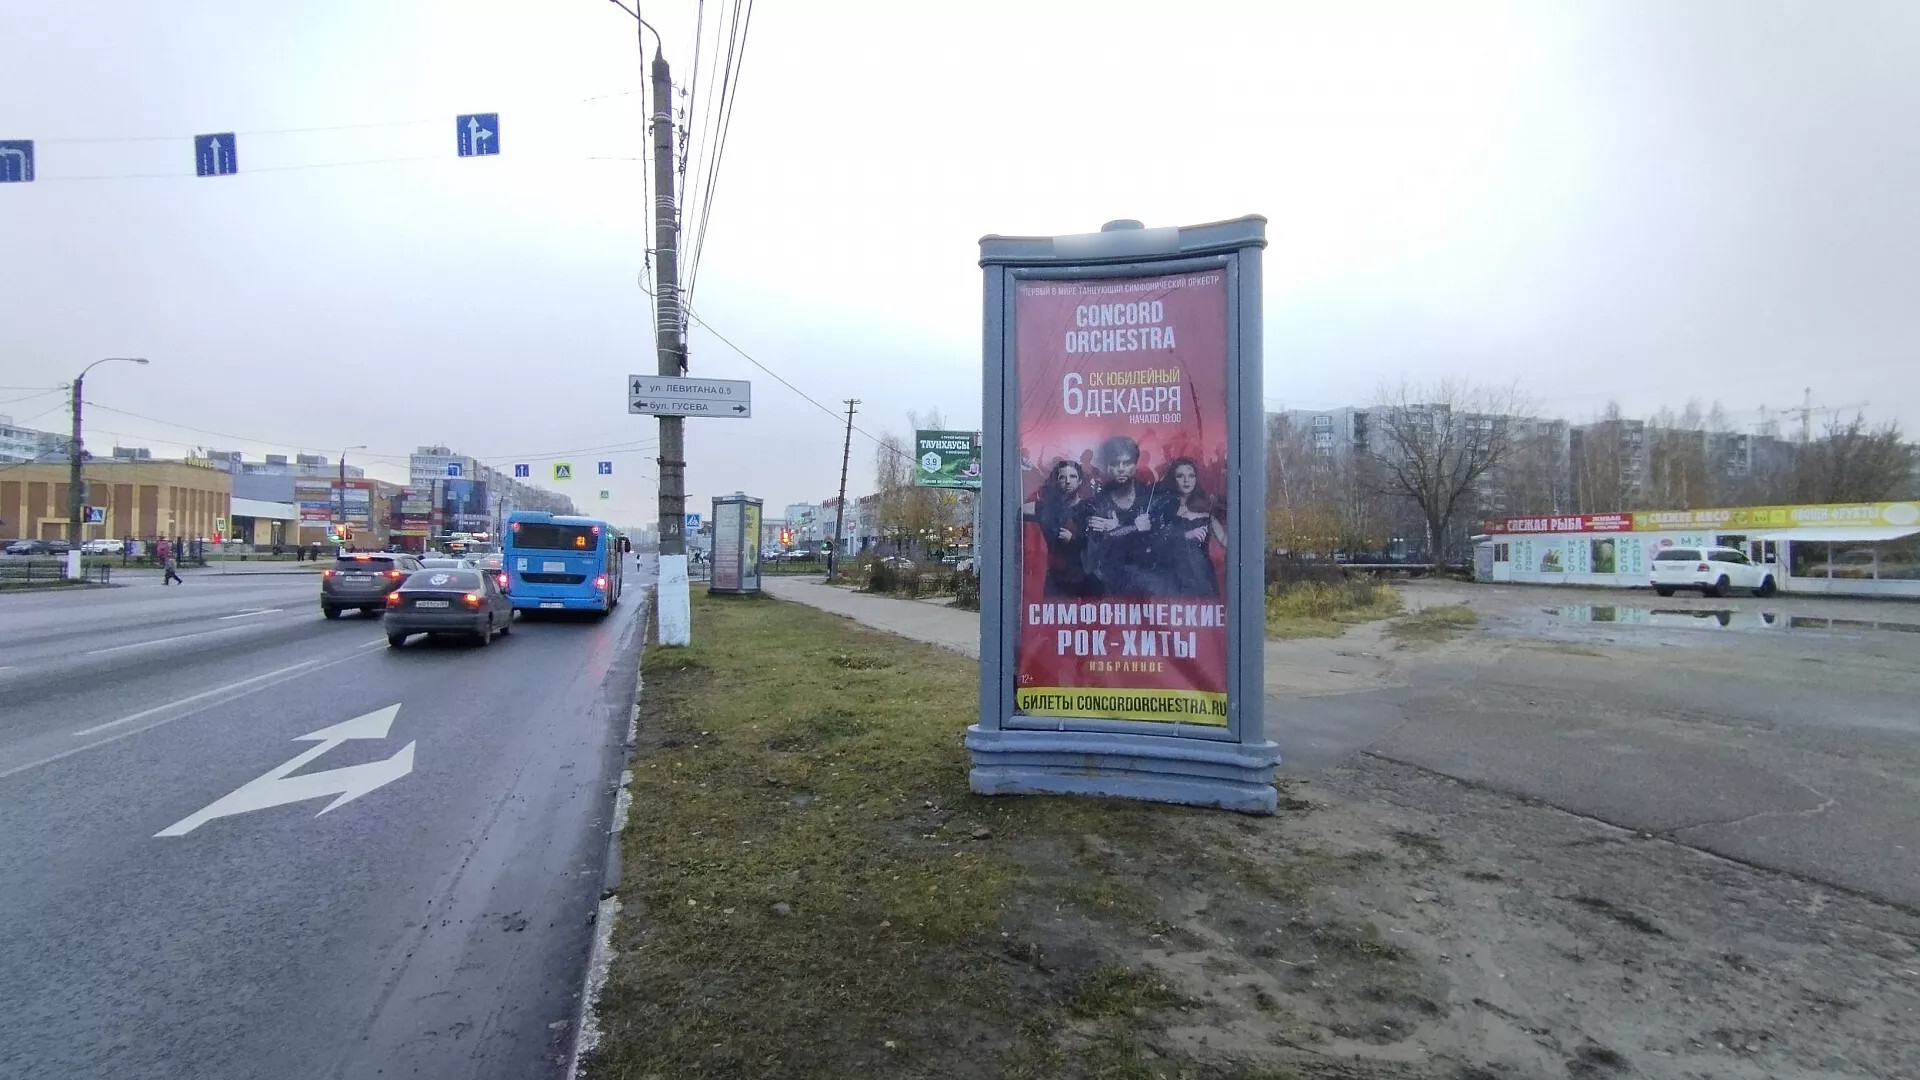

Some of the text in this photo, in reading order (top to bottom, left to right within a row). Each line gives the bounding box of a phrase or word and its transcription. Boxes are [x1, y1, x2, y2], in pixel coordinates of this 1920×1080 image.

[1052, 287, 1057, 296] В
[1058, 286, 1077, 296] МИРЕ
[1079, 284, 1124, 296] ТАНЦУЮЩИЙ
[1125, 279, 1187, 293] СИМФОНИЧЕСКИЙ
[1188, 275, 1220, 287] ОРКЕСТР
[1076, 301, 1164, 327] CONCORD
[1065, 326, 1175, 353] ORCHESTRA
[1089, 366, 1181, 386] СК ЮБИЛЕЙНЫЙ
[666, 384, 717, 394] ЛЕВИТАНА
[1063, 372, 1181, 417] 6 ДЕКАБРЯ
[649, 402, 709, 411] бул. ГУСЕВА
[1129, 413, 1182, 425] НАЧАЛО 19:00
[920, 440, 969, 449] ТАУНХАУСЫ
[1507, 519, 1548, 531] СВЕЖАЯ
[1550, 517, 1583, 531] РЫБА
[1620, 538, 1629, 571] МЯСО
[1029, 603, 1225, 627] СИМФОНИЧЕСКИЕ
[1058, 630, 1197, 659] РОК-ХИТЫ
[1089, 661, 1164, 673] ИЗБРАННОЕ
[1021, 674, 1034, 684] 12+
[1022, 694, 1227, 716] БИЛЕТЫ CONCORDORCHESTRA.RU
